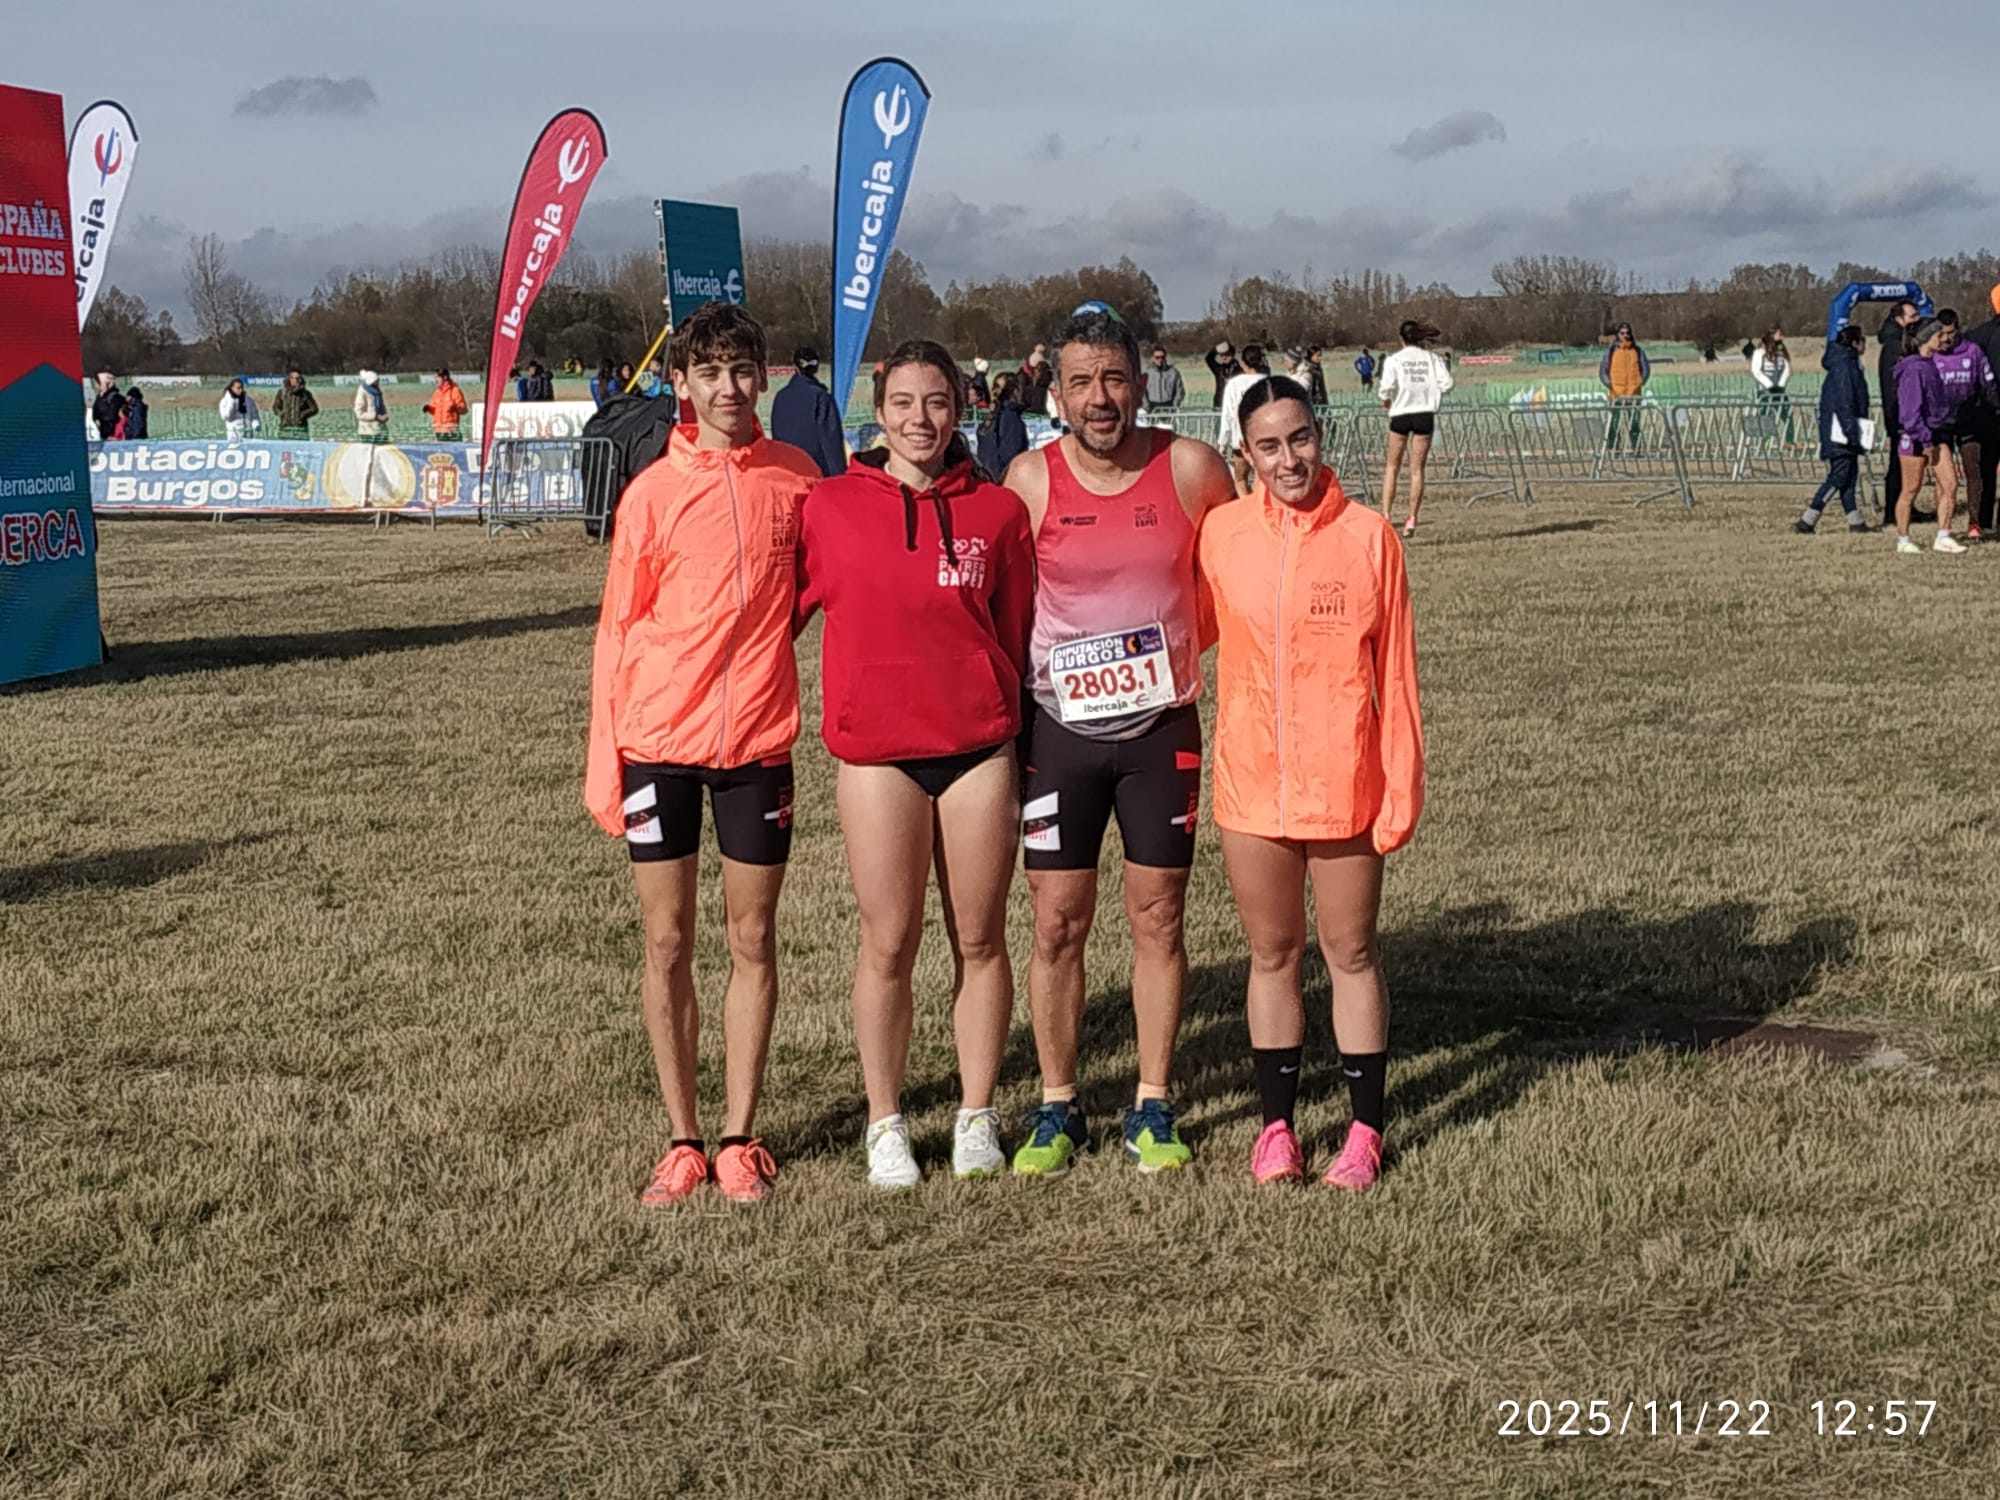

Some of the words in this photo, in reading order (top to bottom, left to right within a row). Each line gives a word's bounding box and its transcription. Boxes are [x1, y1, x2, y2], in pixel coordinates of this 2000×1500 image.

[842, 160, 895, 311] Ibercaja
[0, 246, 65, 276] CLUBES
[500, 203, 563, 340] Ibercaja
[673, 268, 722, 302] Ibercaja
[106, 476, 265, 506] Burgos
[0, 509, 86, 565] ERCA
[1054, 647, 1126, 670] BURGOS
[1064, 658, 1158, 701] 2803.1
[1083, 699, 1129, 713] Ibercaja
